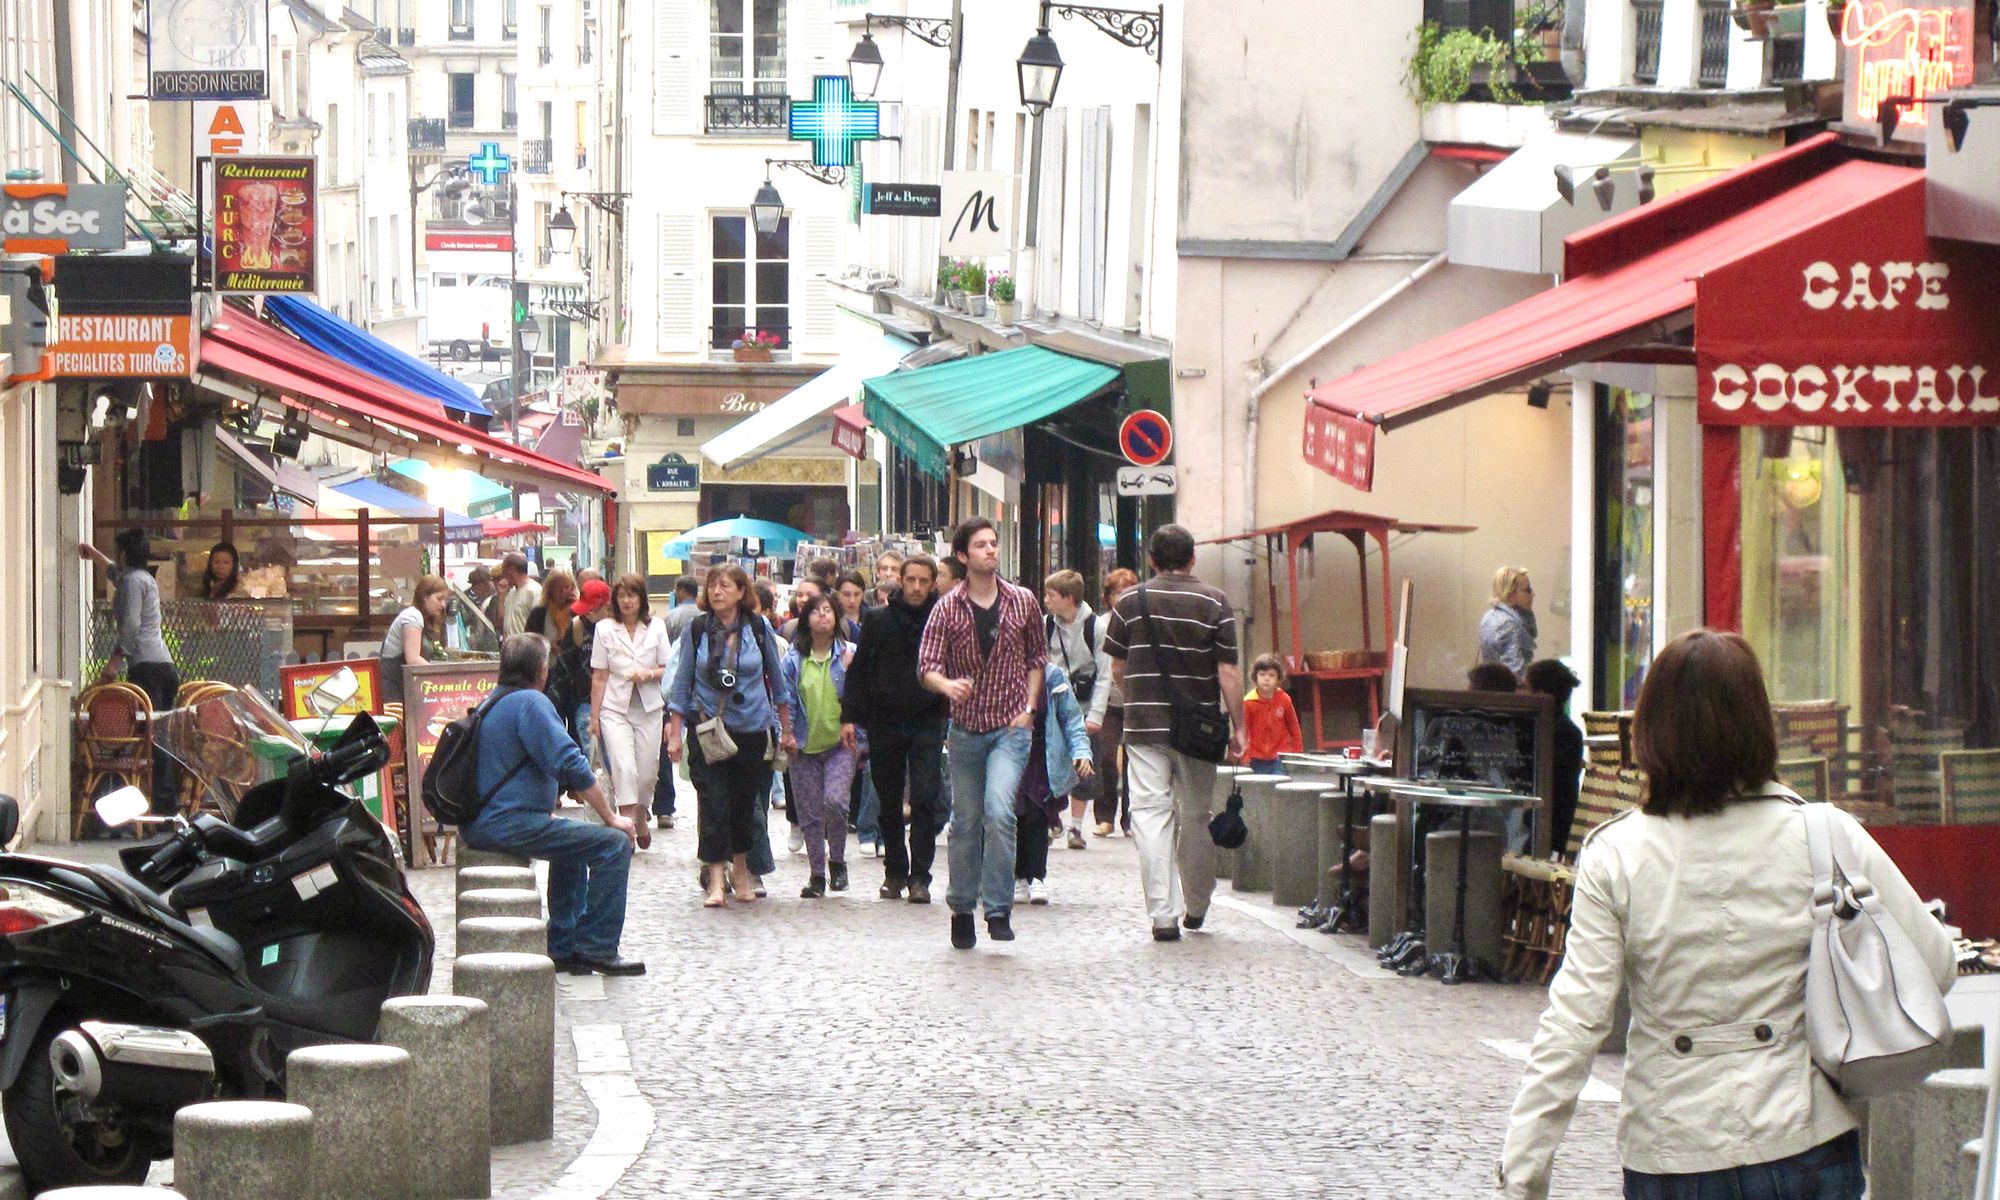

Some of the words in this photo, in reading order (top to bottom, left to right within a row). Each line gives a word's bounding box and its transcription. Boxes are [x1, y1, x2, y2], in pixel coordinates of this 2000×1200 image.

[155, 73, 263, 93] POISSONNERIE
[220, 163, 309, 178] Restaurant
[874, 191, 894, 203] Jeff
[903, 190, 938, 205] Bruges
[222, 195, 235, 259] TURC
[1802, 261, 1950, 310] CAFE
[60, 317, 173, 342] RESTAURANT
[56, 353, 125, 373] PECIALITES
[1711, 363, 2000, 412] COCKTAIL
[421, 679, 472, 695] Formule
